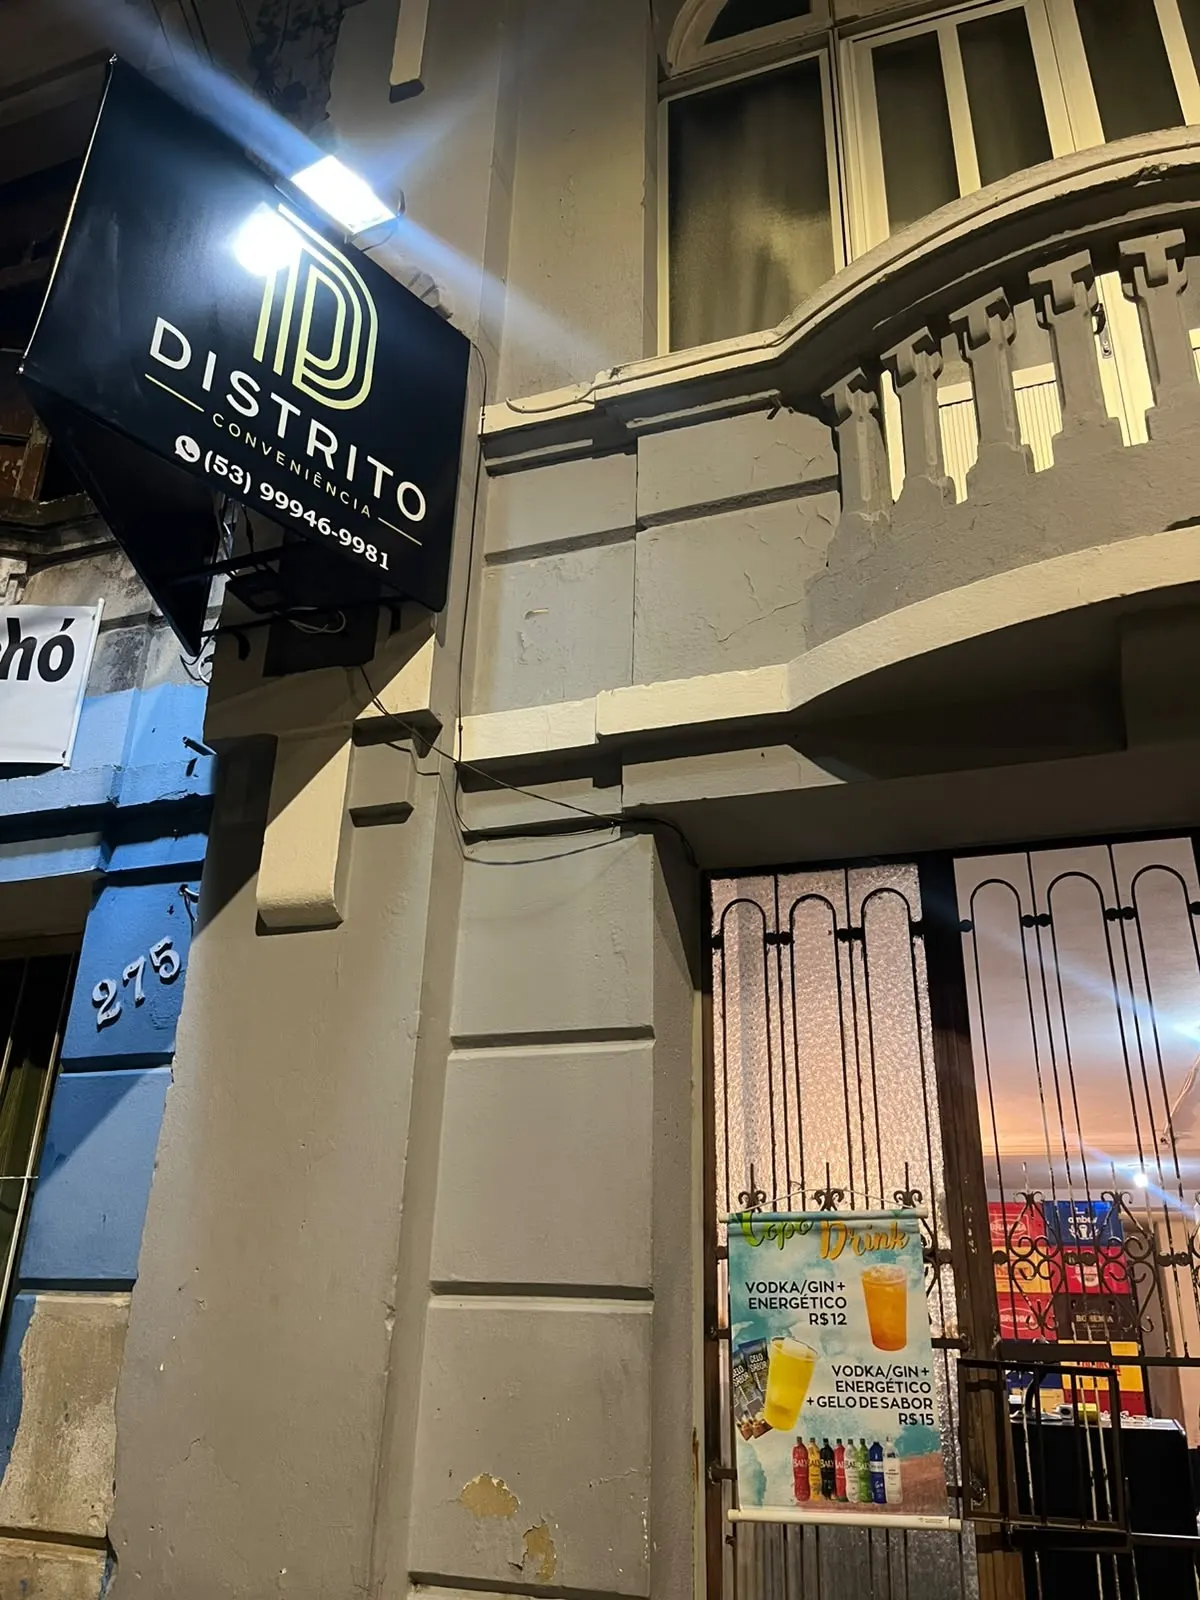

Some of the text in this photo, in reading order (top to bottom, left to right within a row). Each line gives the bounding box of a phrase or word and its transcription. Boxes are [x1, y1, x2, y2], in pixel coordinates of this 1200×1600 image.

[149, 315, 427, 523] DISTRITO
[212, 412, 372, 518] CONVENIÊNCIA
[203, 450, 390, 571] (53) 99946-9981
[0, 617, 76, 683] hó
[92, 935, 181, 1026] 275
[819, 1218, 911, 1261] Drink
[748, 1294, 848, 1310] ENERGÉTICO
[835, 1378, 932, 1394] ENERGÉTICO
